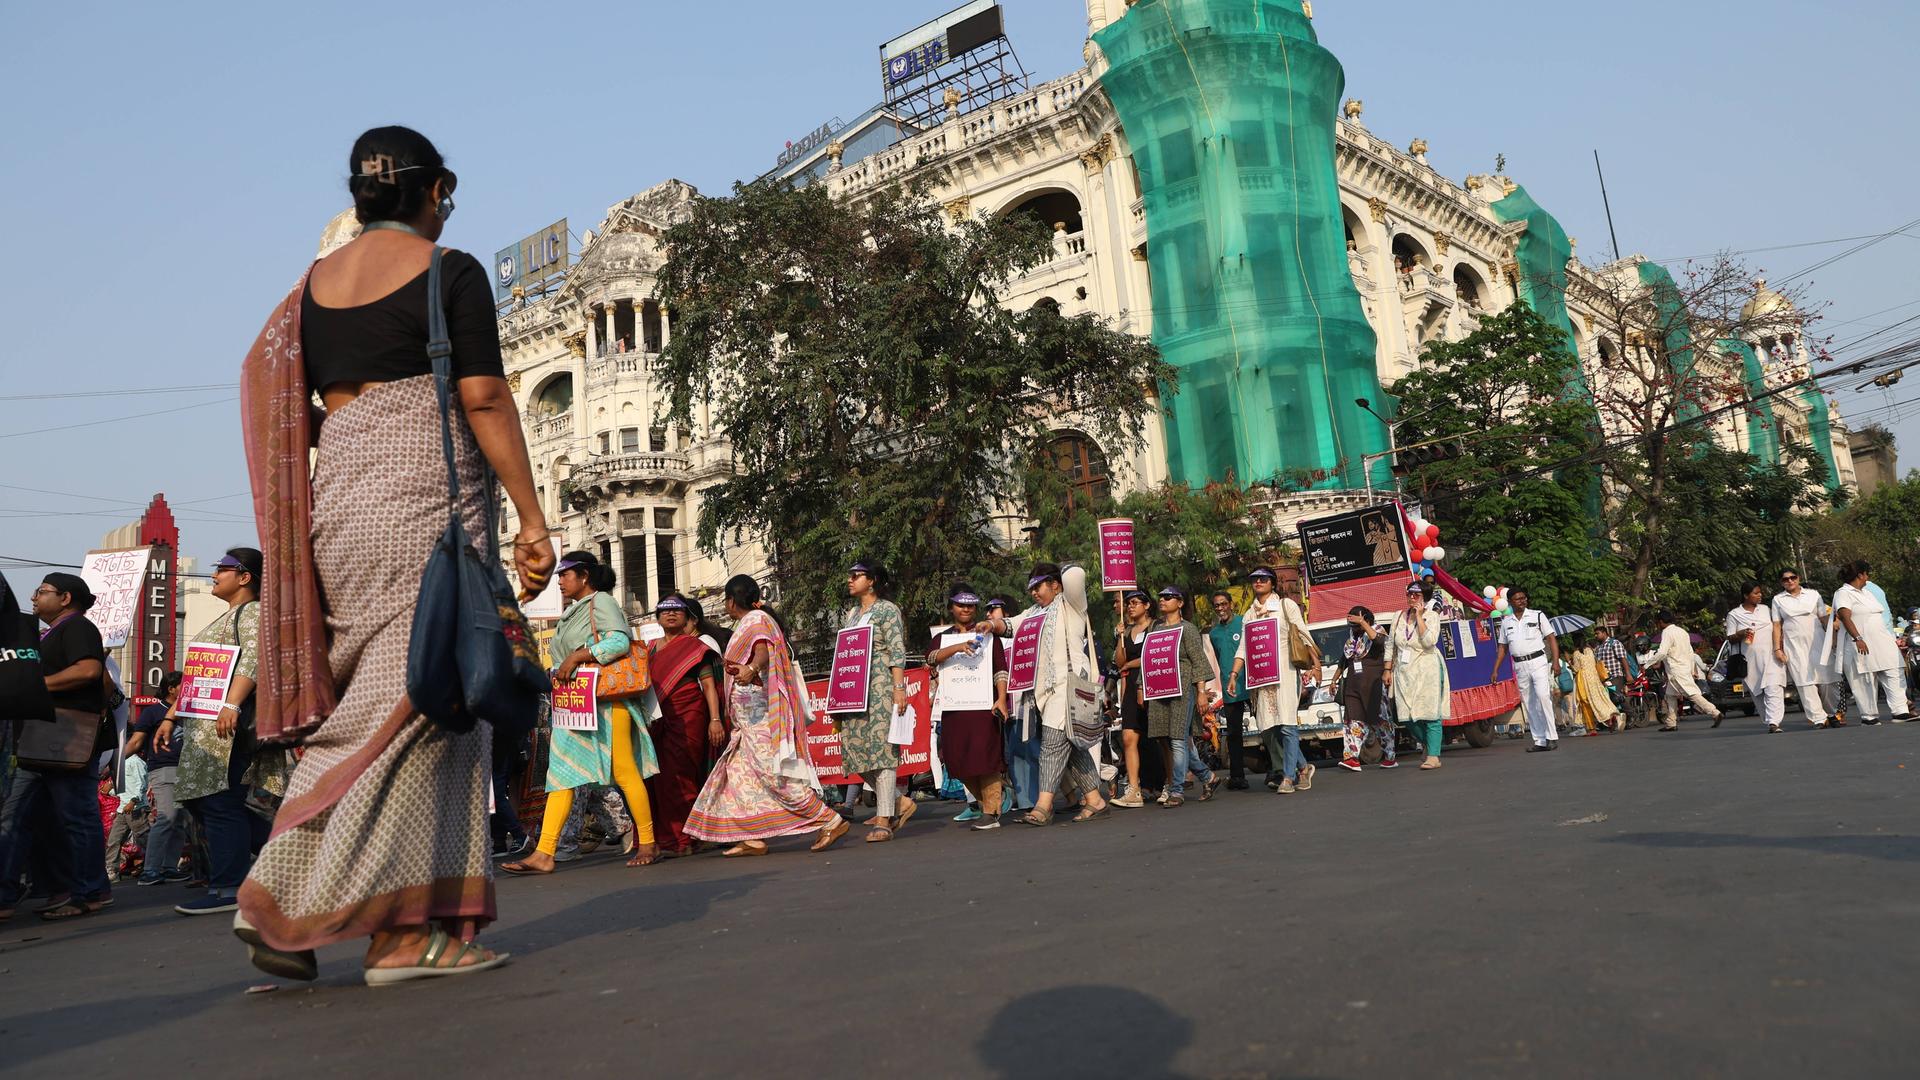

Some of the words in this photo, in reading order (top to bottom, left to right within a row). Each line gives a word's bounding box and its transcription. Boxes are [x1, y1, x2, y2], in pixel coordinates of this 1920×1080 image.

[912, 41, 943, 72] LIC
[777, 122, 832, 166] SIDDHA
[528, 233, 559, 273] LIC
[147, 558, 167, 688] METRO
[570, 691, 586, 708] দিন
